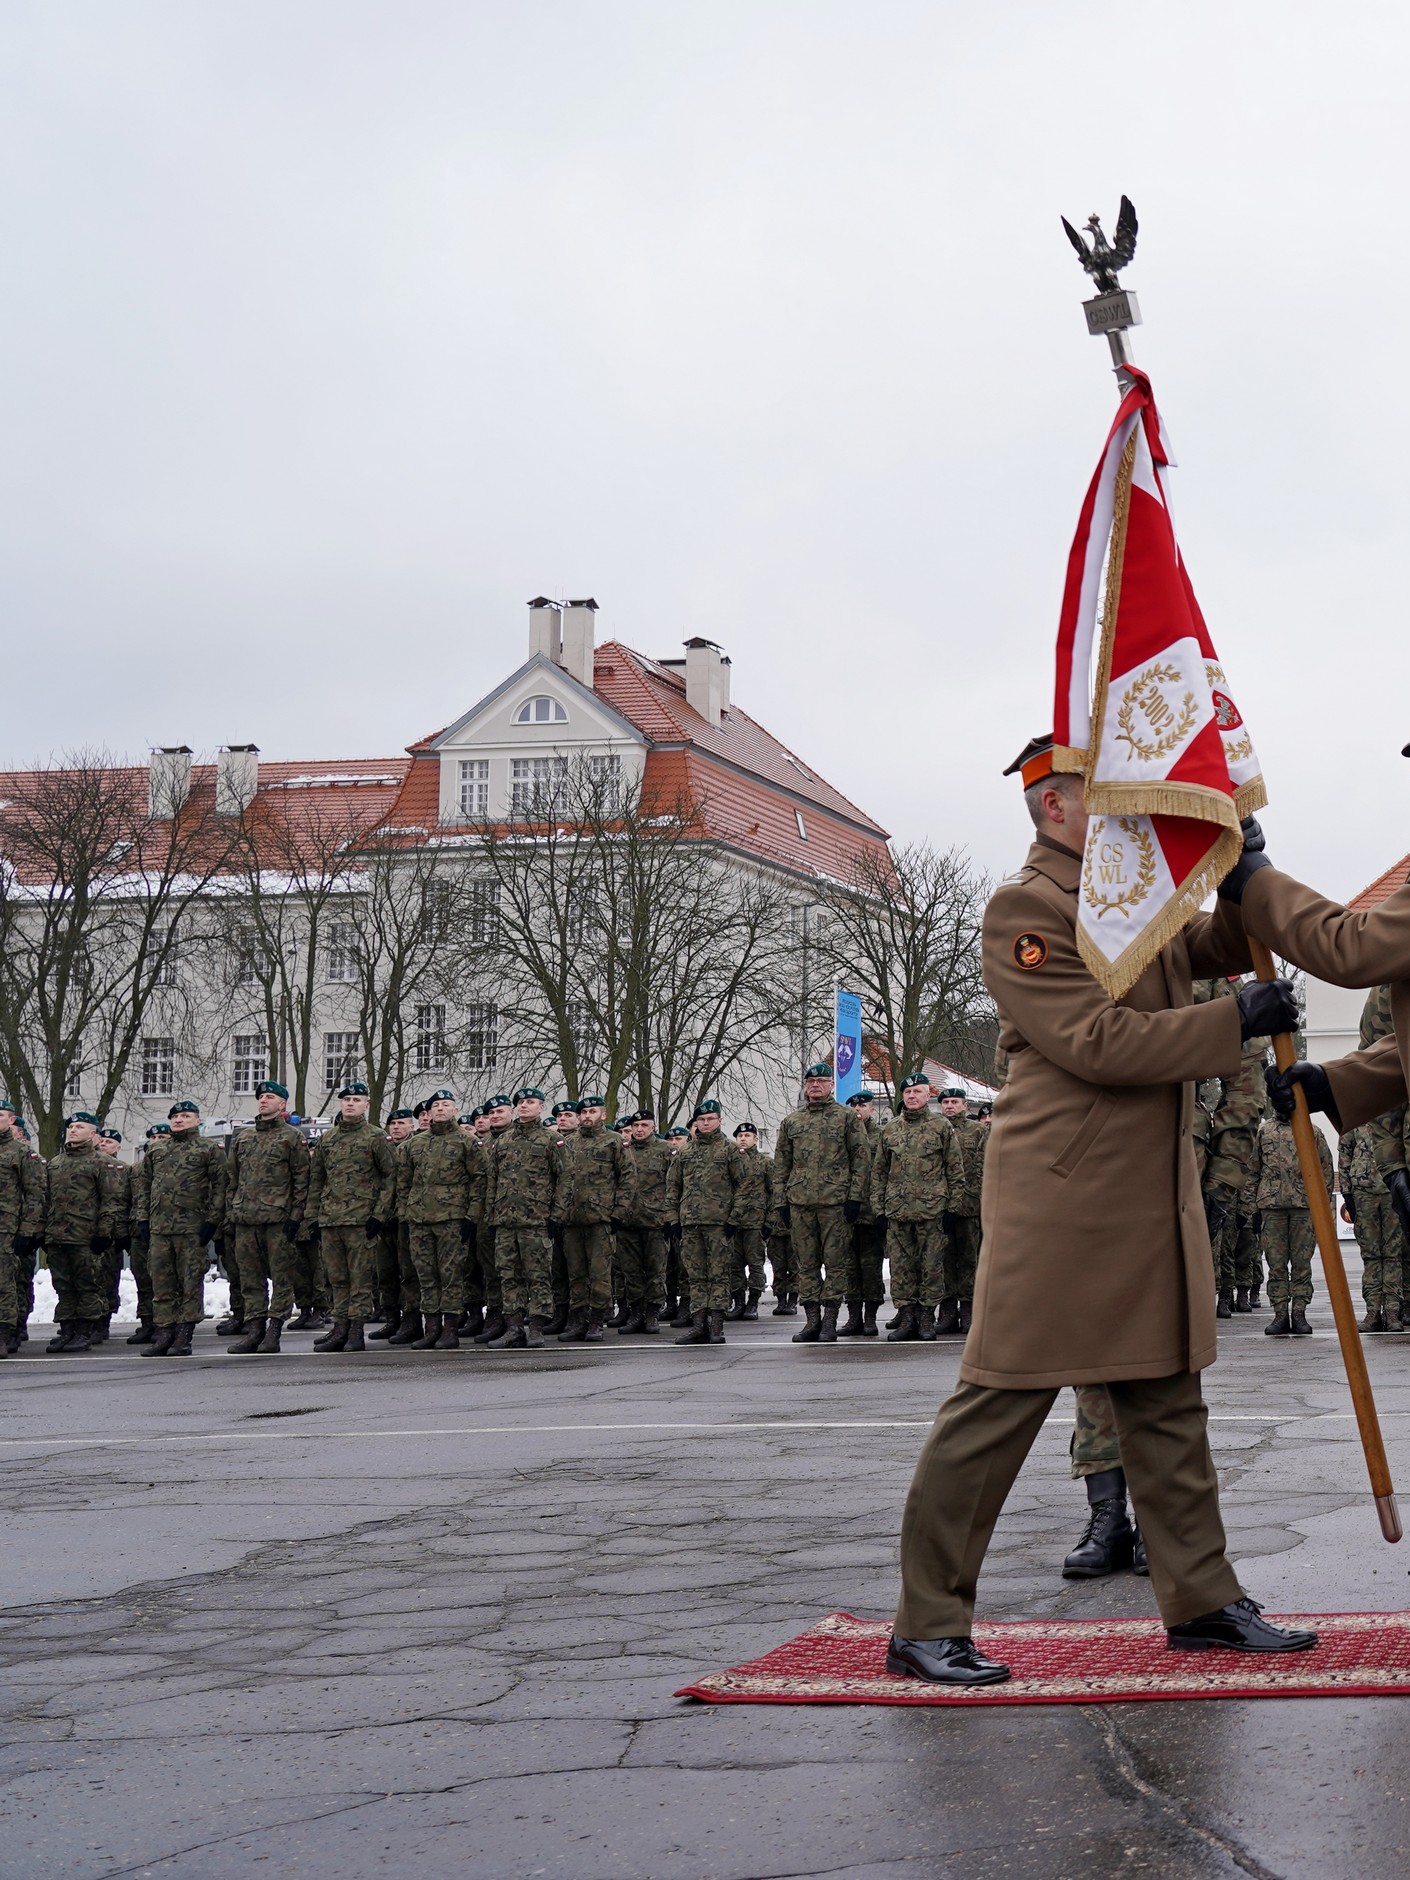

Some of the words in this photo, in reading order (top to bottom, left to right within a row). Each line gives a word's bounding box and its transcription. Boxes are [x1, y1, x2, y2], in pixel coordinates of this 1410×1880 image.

[1138, 686, 1174, 736] 2002
[1100, 843, 1124, 863] CS
[1098, 864, 1127, 884] WL
